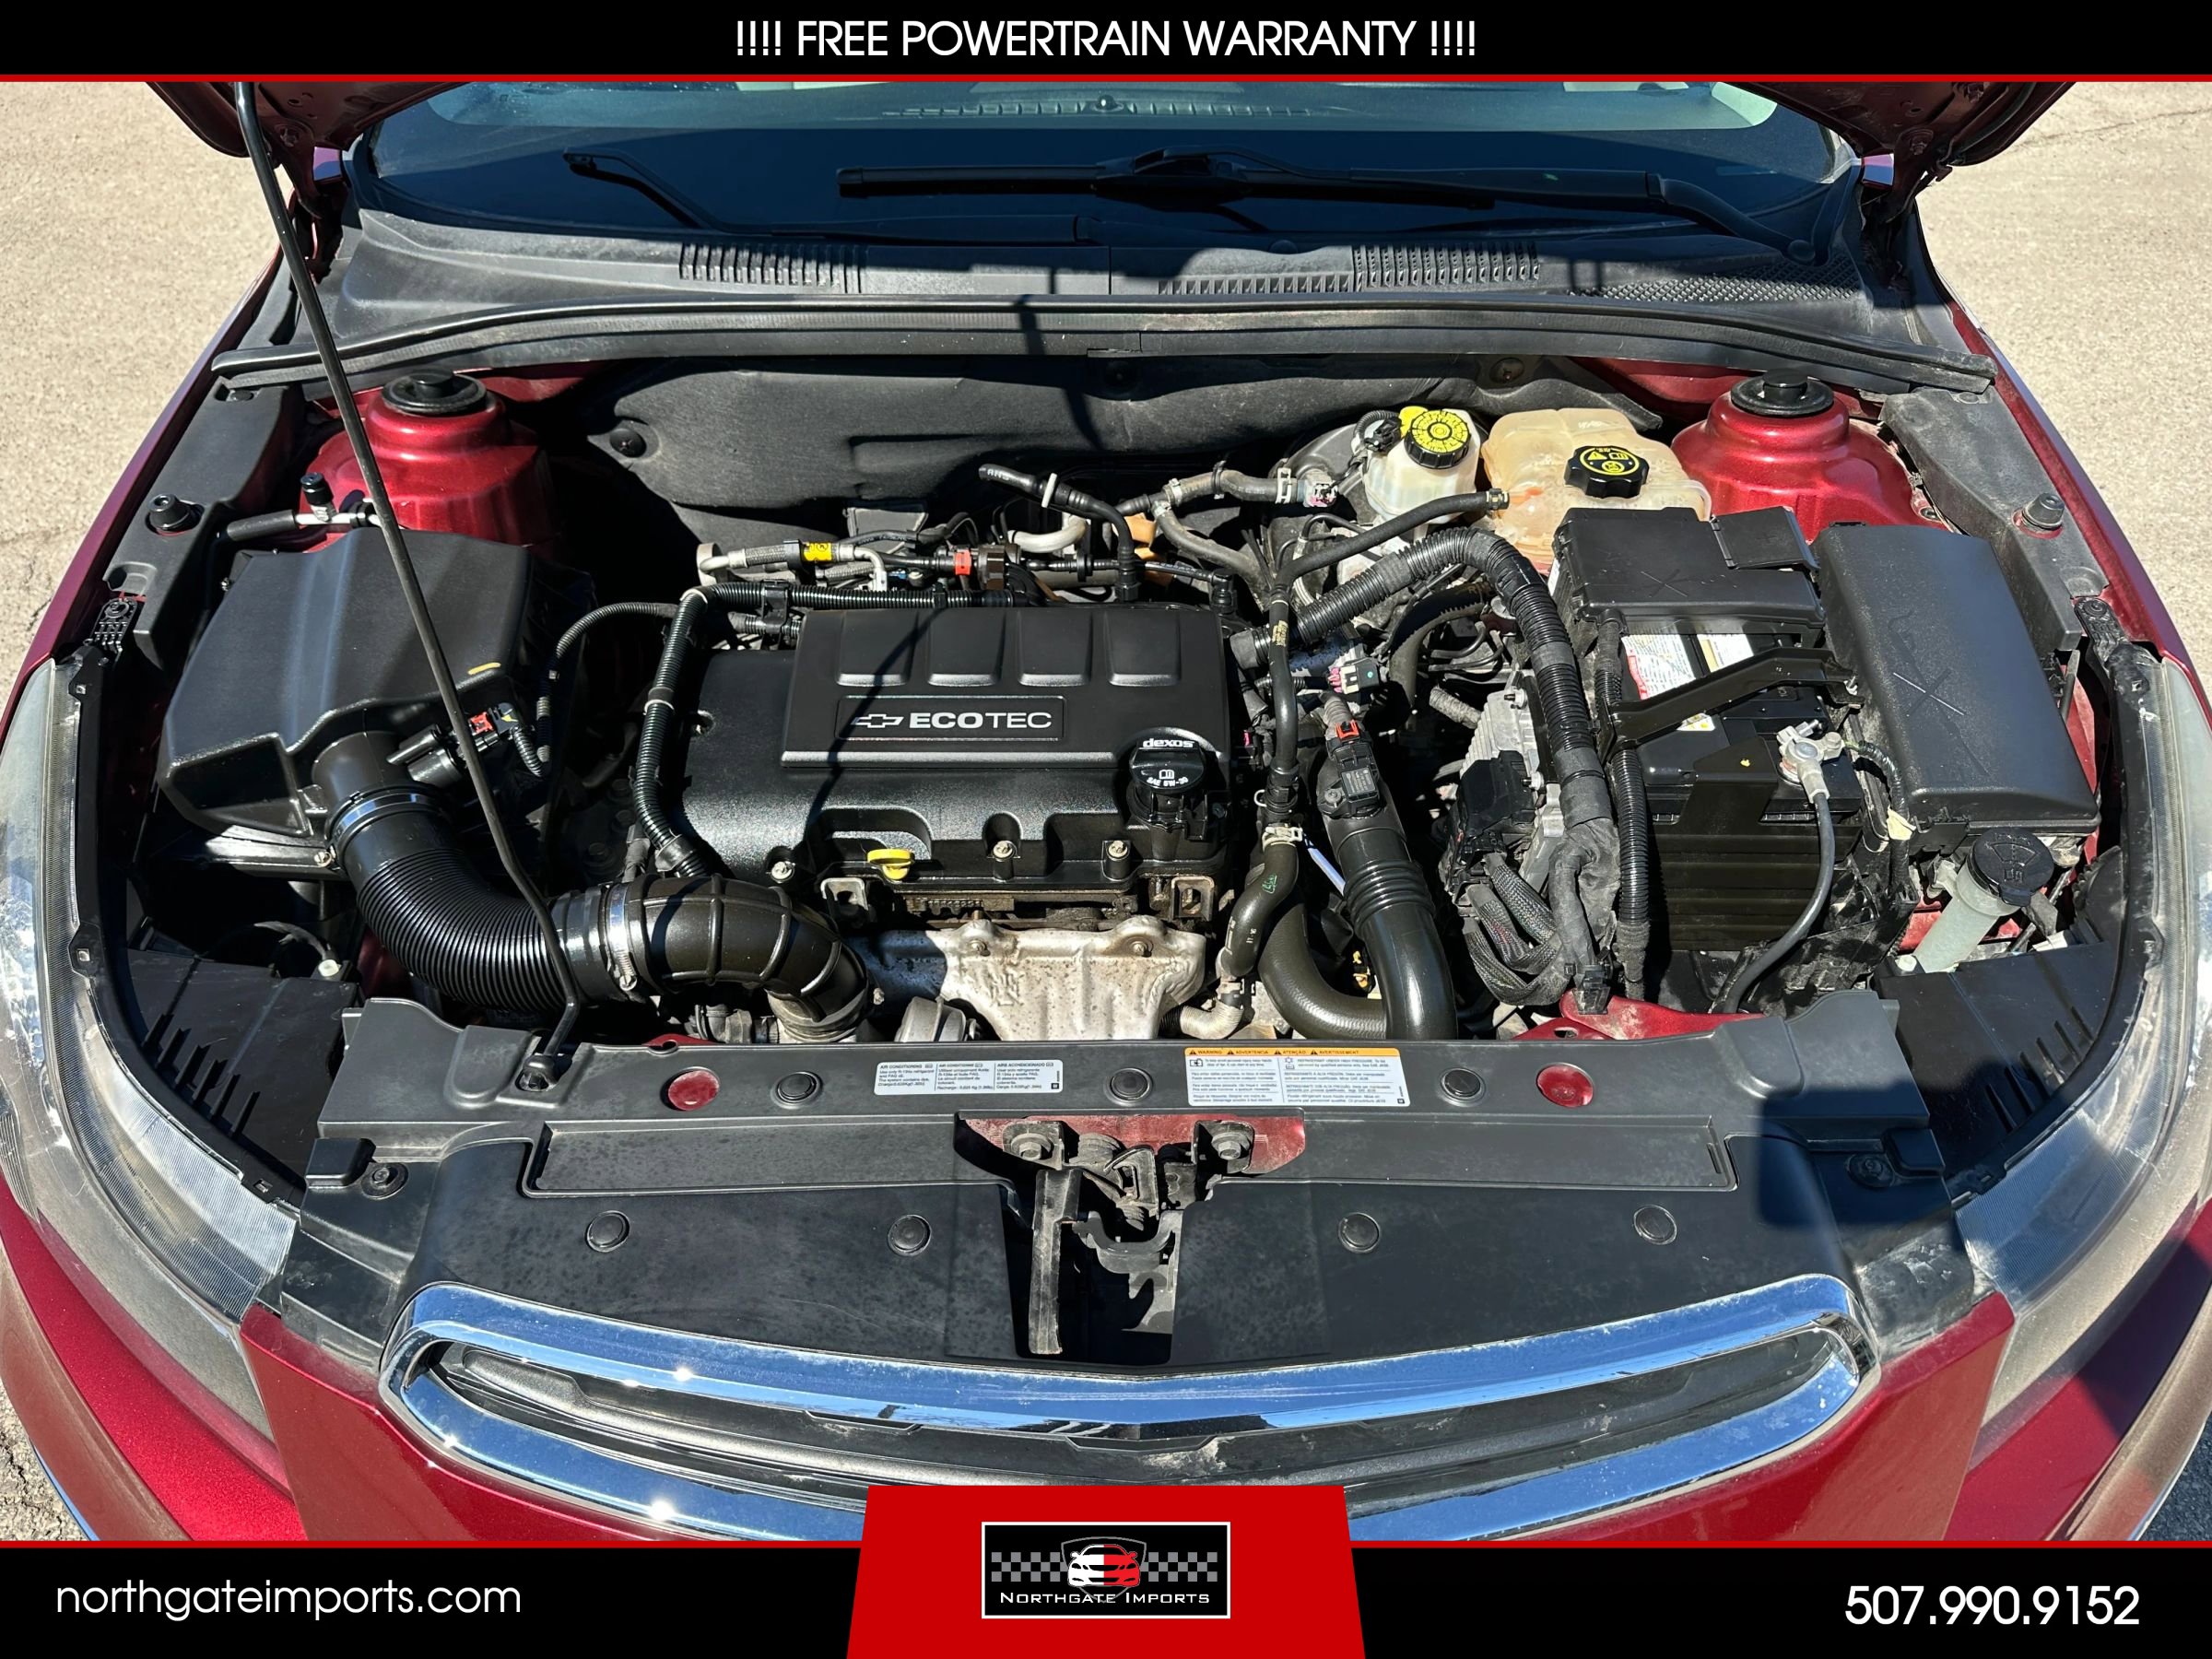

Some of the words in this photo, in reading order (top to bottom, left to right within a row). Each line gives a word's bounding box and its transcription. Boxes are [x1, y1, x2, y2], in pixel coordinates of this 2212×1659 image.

[909, 712, 1052, 729] ECOTEC
[1143, 738, 1195, 748] dexos
[1147, 776, 1161, 787] SAE
[1163, 776, 1189, 787] 5W-30
